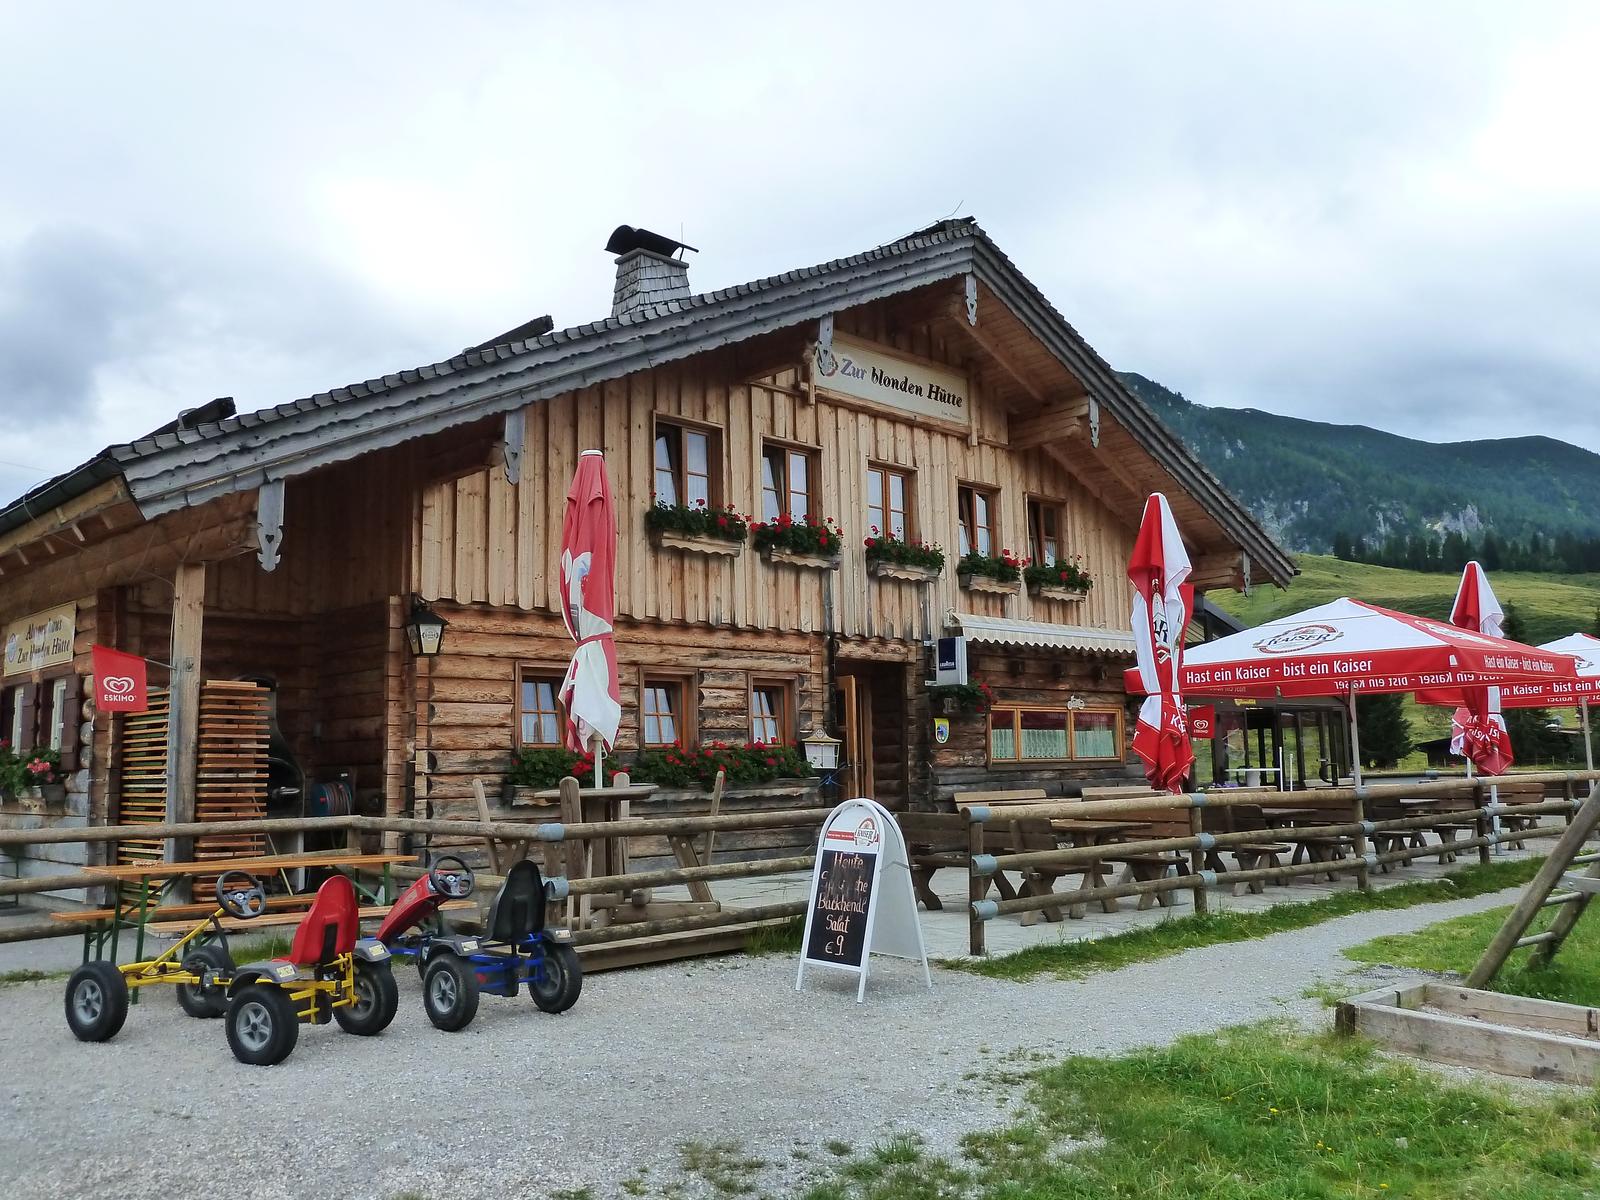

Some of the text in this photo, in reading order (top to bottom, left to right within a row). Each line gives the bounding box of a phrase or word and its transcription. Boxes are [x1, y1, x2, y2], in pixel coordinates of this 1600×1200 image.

[840, 358, 963, 407] Zur blonden Hütte
[1186, 670, 1210, 684] Hast
[1214, 668, 1232, 681] ein
[1236, 666, 1271, 680] Kaiser
[1283, 662, 1306, 677] bist
[1310, 661, 1329, 675] ein
[1333, 658, 1372, 674] Kaiser
[1513, 685, 1543, 695] Kaiser
[1553, 681, 1572, 693] bist
[1575, 680, 1591, 691] ein
[104, 694, 134, 702] ESKIMO
[826, 914, 850, 933] Salat
